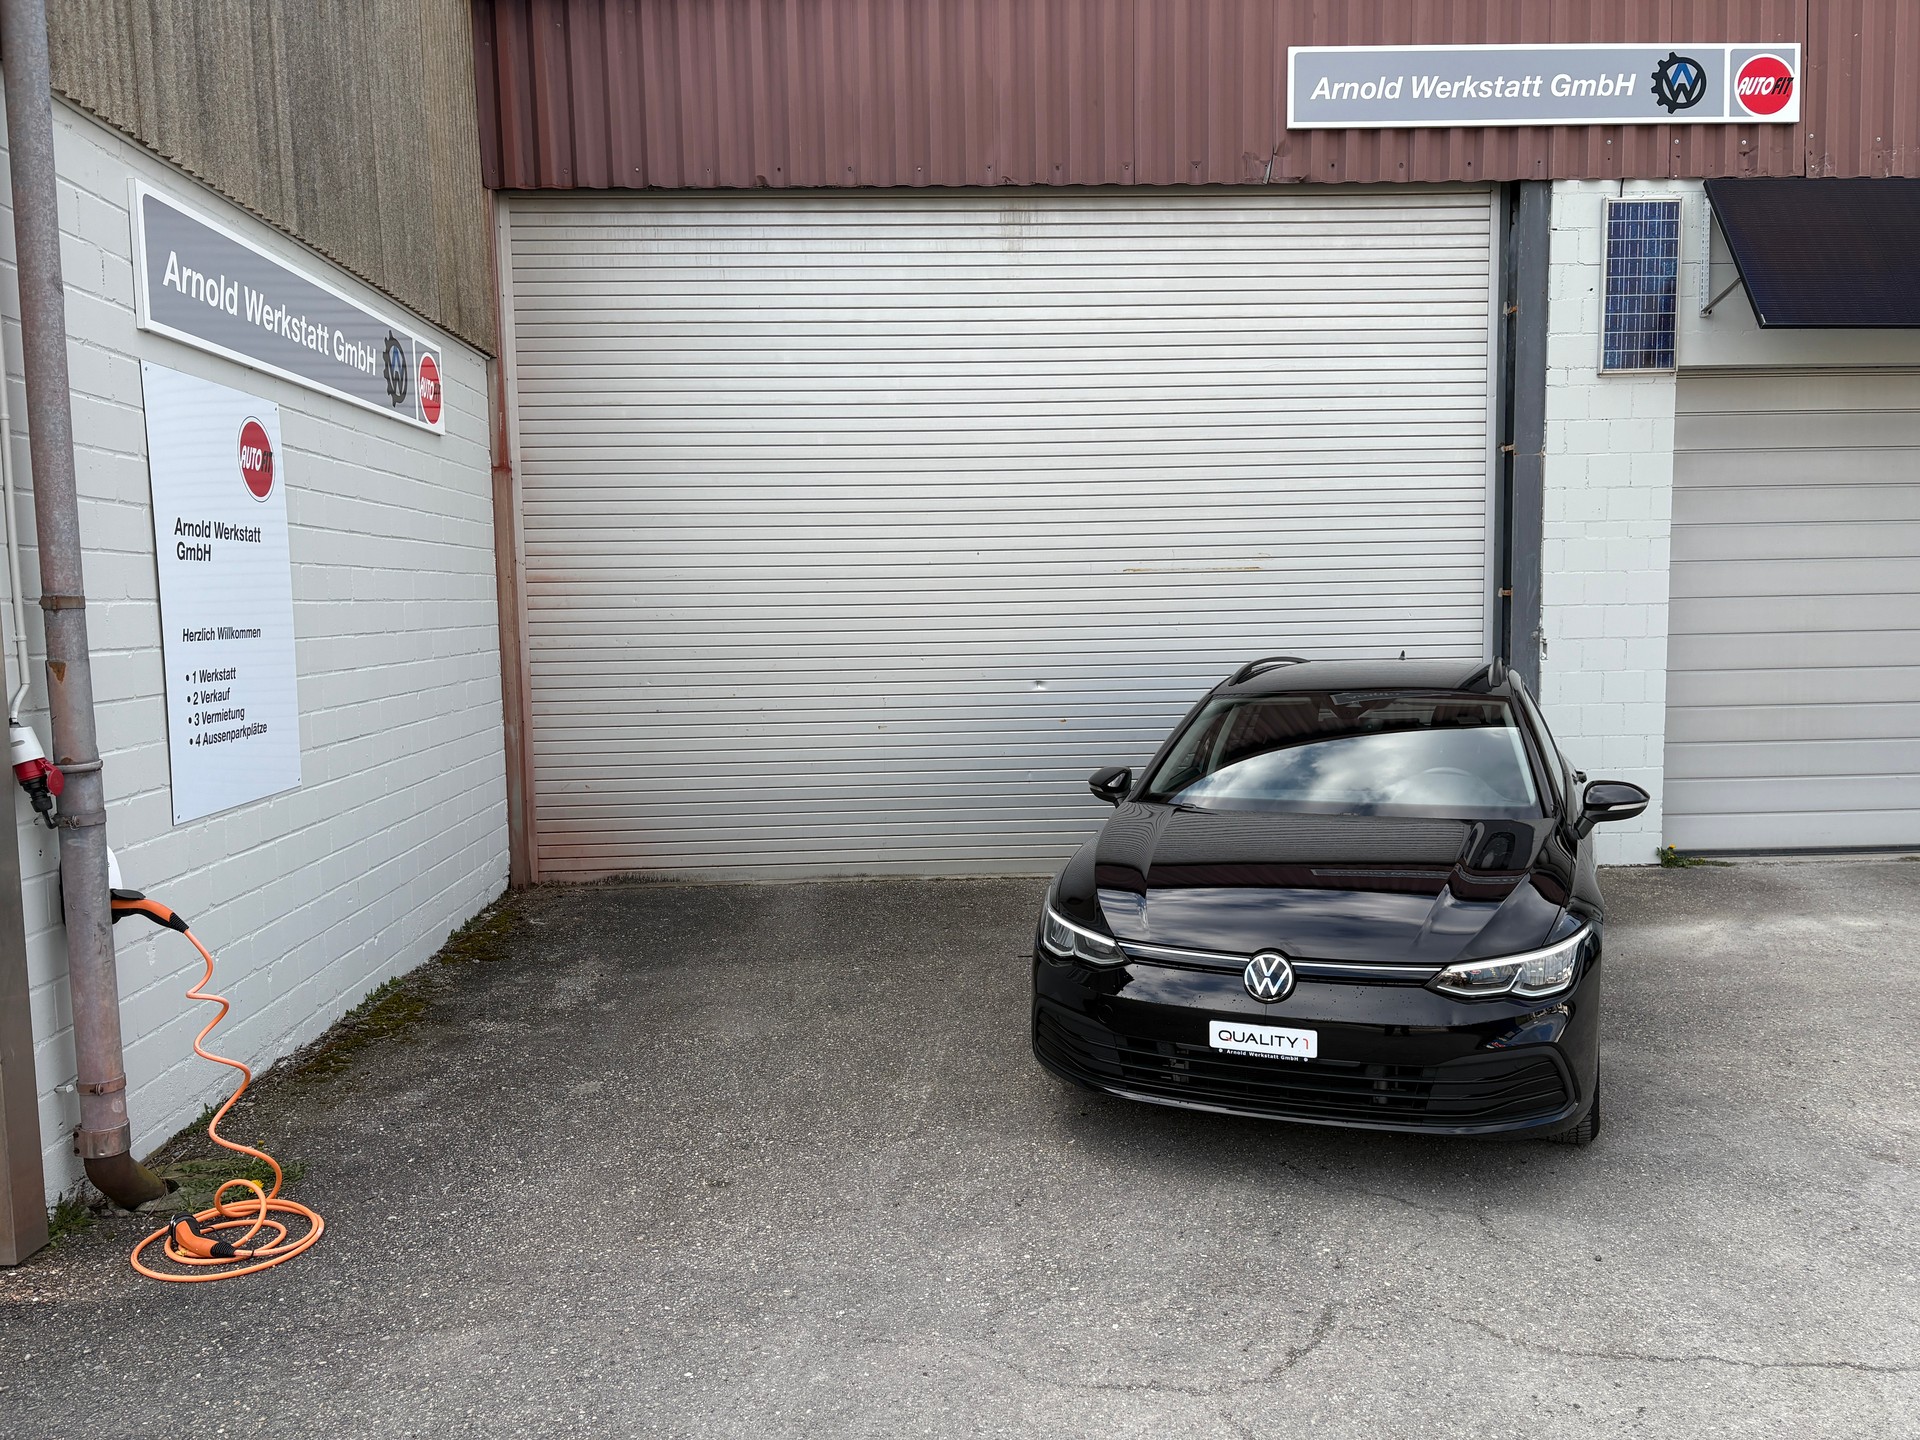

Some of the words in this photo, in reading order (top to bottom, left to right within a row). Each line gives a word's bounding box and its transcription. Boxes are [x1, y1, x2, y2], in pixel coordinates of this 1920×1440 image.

[1310, 76, 1403, 100] Arnold
[1411, 74, 1543, 98] Werkstatt
[1549, 73, 1637, 97] GmbH
[1738, 76, 1794, 96] AUTOFIT
[162, 250, 238, 316] Arnold
[244, 285, 329, 355] Werkstatt
[332, 330, 376, 376] GmbH
[240, 445, 273, 474] AUTOFIT
[174, 517, 211, 538] Arnold
[214, 521, 261, 543] Werkstatt
[176, 541, 211, 561] GmbH
[182, 627, 215, 642] Herzlich
[217, 626, 261, 640] Willkommen
[192, 670, 197, 684] 1
[199, 667, 236, 683] Werkstatt
[193, 691, 199, 705] 2
[200, 687, 230, 704] Verkauf
[194, 712, 200, 726] 3
[201, 708, 245, 725] Vermietung
[195, 733, 201, 747] 4
[202, 722, 267, 746] Aussenparkplätze
[1218, 1029, 1298, 1048] QUALITY
[1248, 1051, 1279, 1060] Werkstatt
